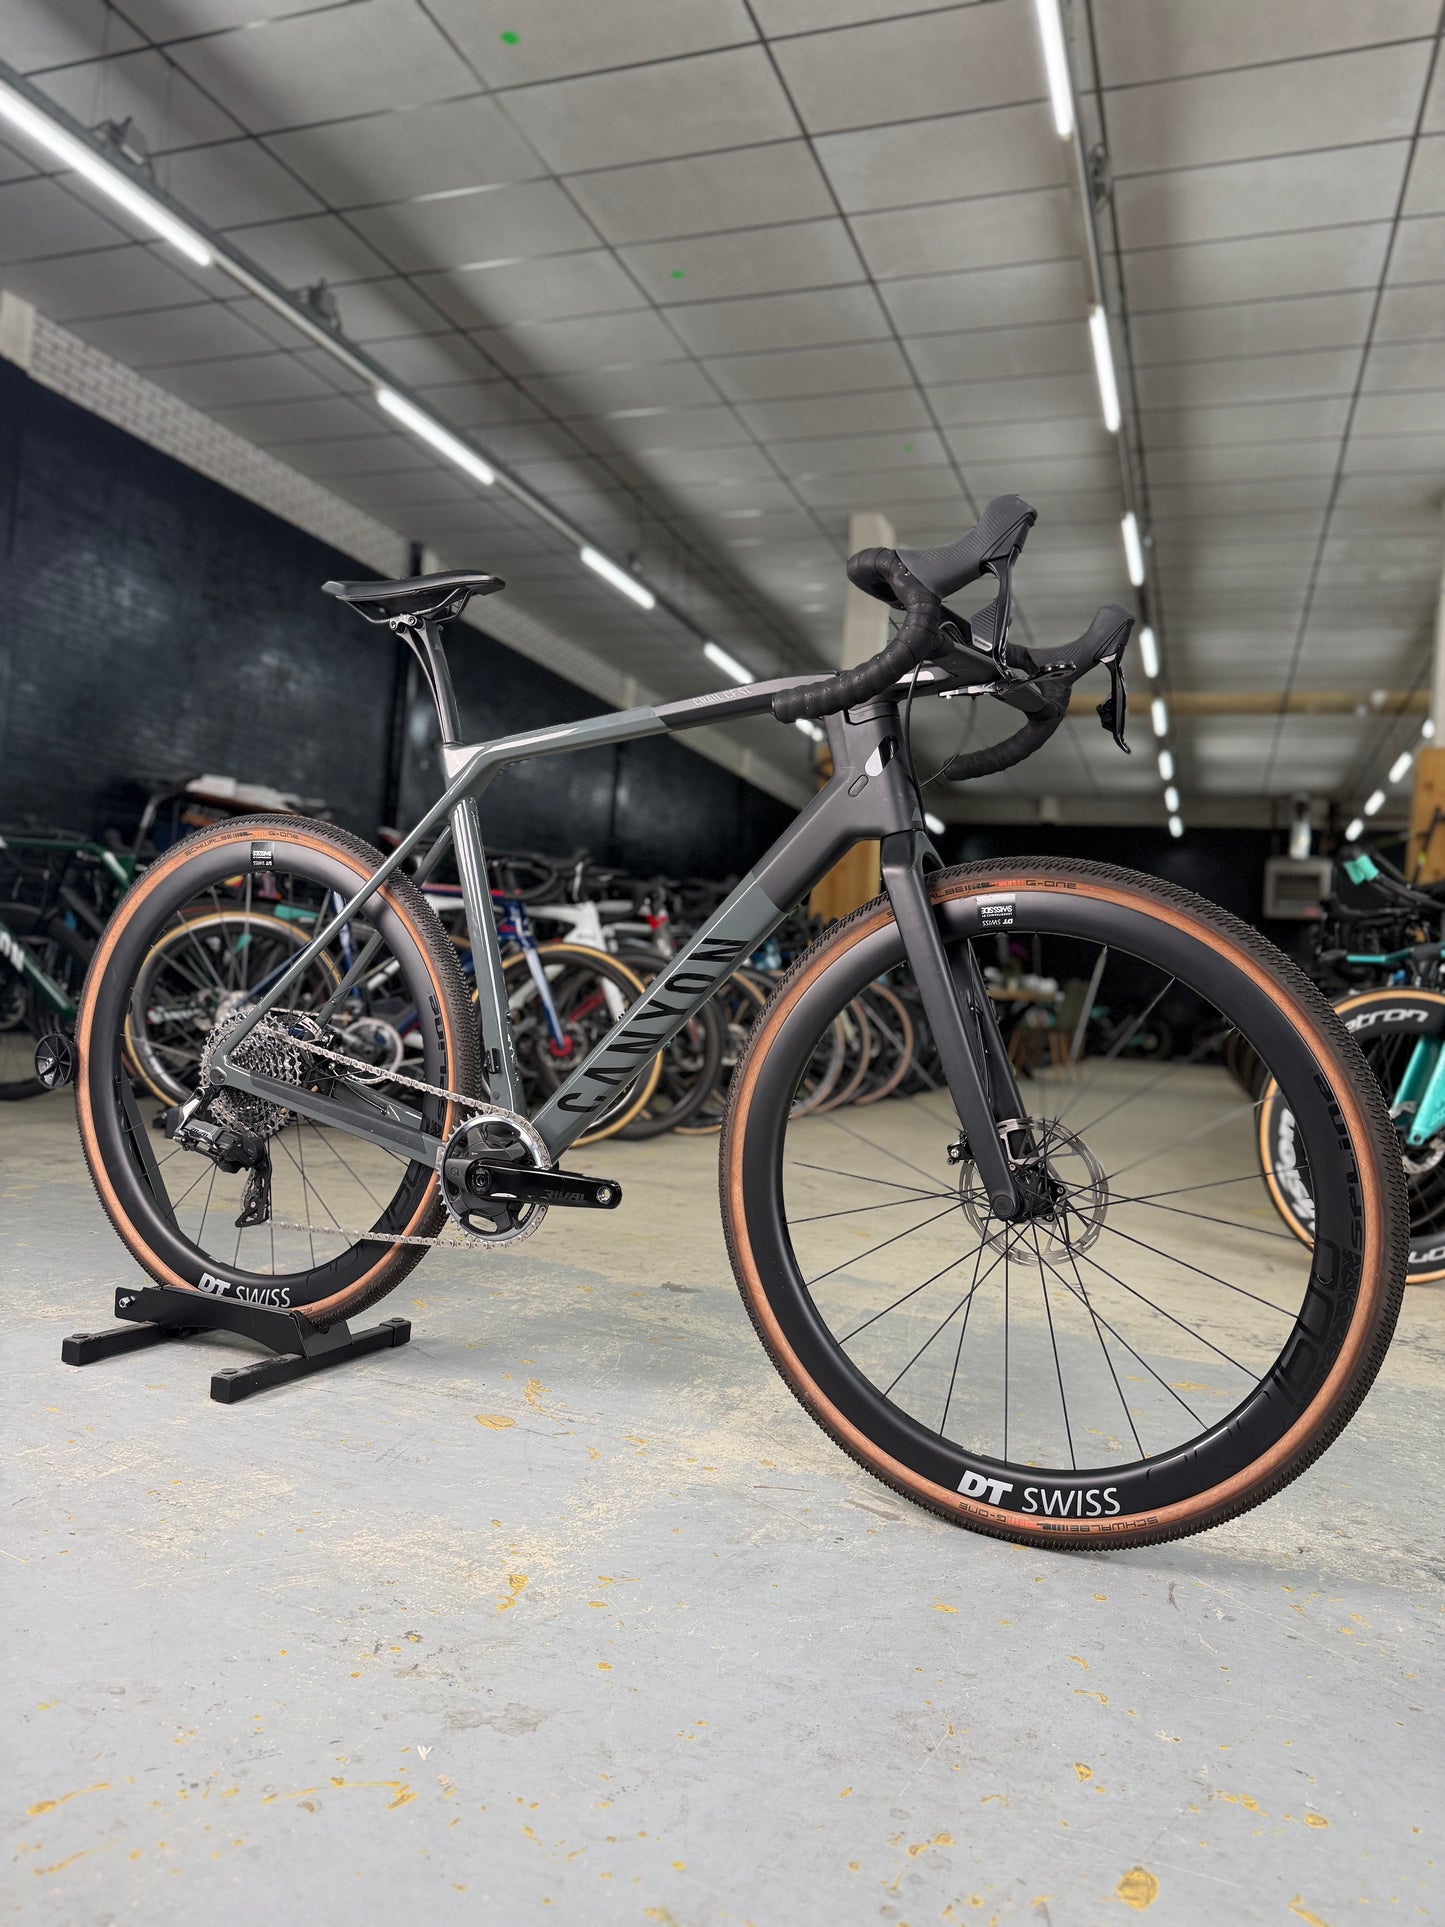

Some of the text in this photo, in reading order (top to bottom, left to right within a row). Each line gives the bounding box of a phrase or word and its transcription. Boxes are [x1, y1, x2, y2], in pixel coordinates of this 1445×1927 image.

[692, 693, 724, 706] GRAIL
[1026, 879, 1077, 889] G-ONE
[557, 937, 750, 1113] CANYON
[1344, 1008, 1429, 1034] etron
[544, 1189, 586, 1201] RIVAL
[198, 1272, 291, 1308] DT SWISS
[957, 1470, 1121, 1517] DT SWISS
[959, 1502, 1159, 1532] SCHWALBE G-ONE
